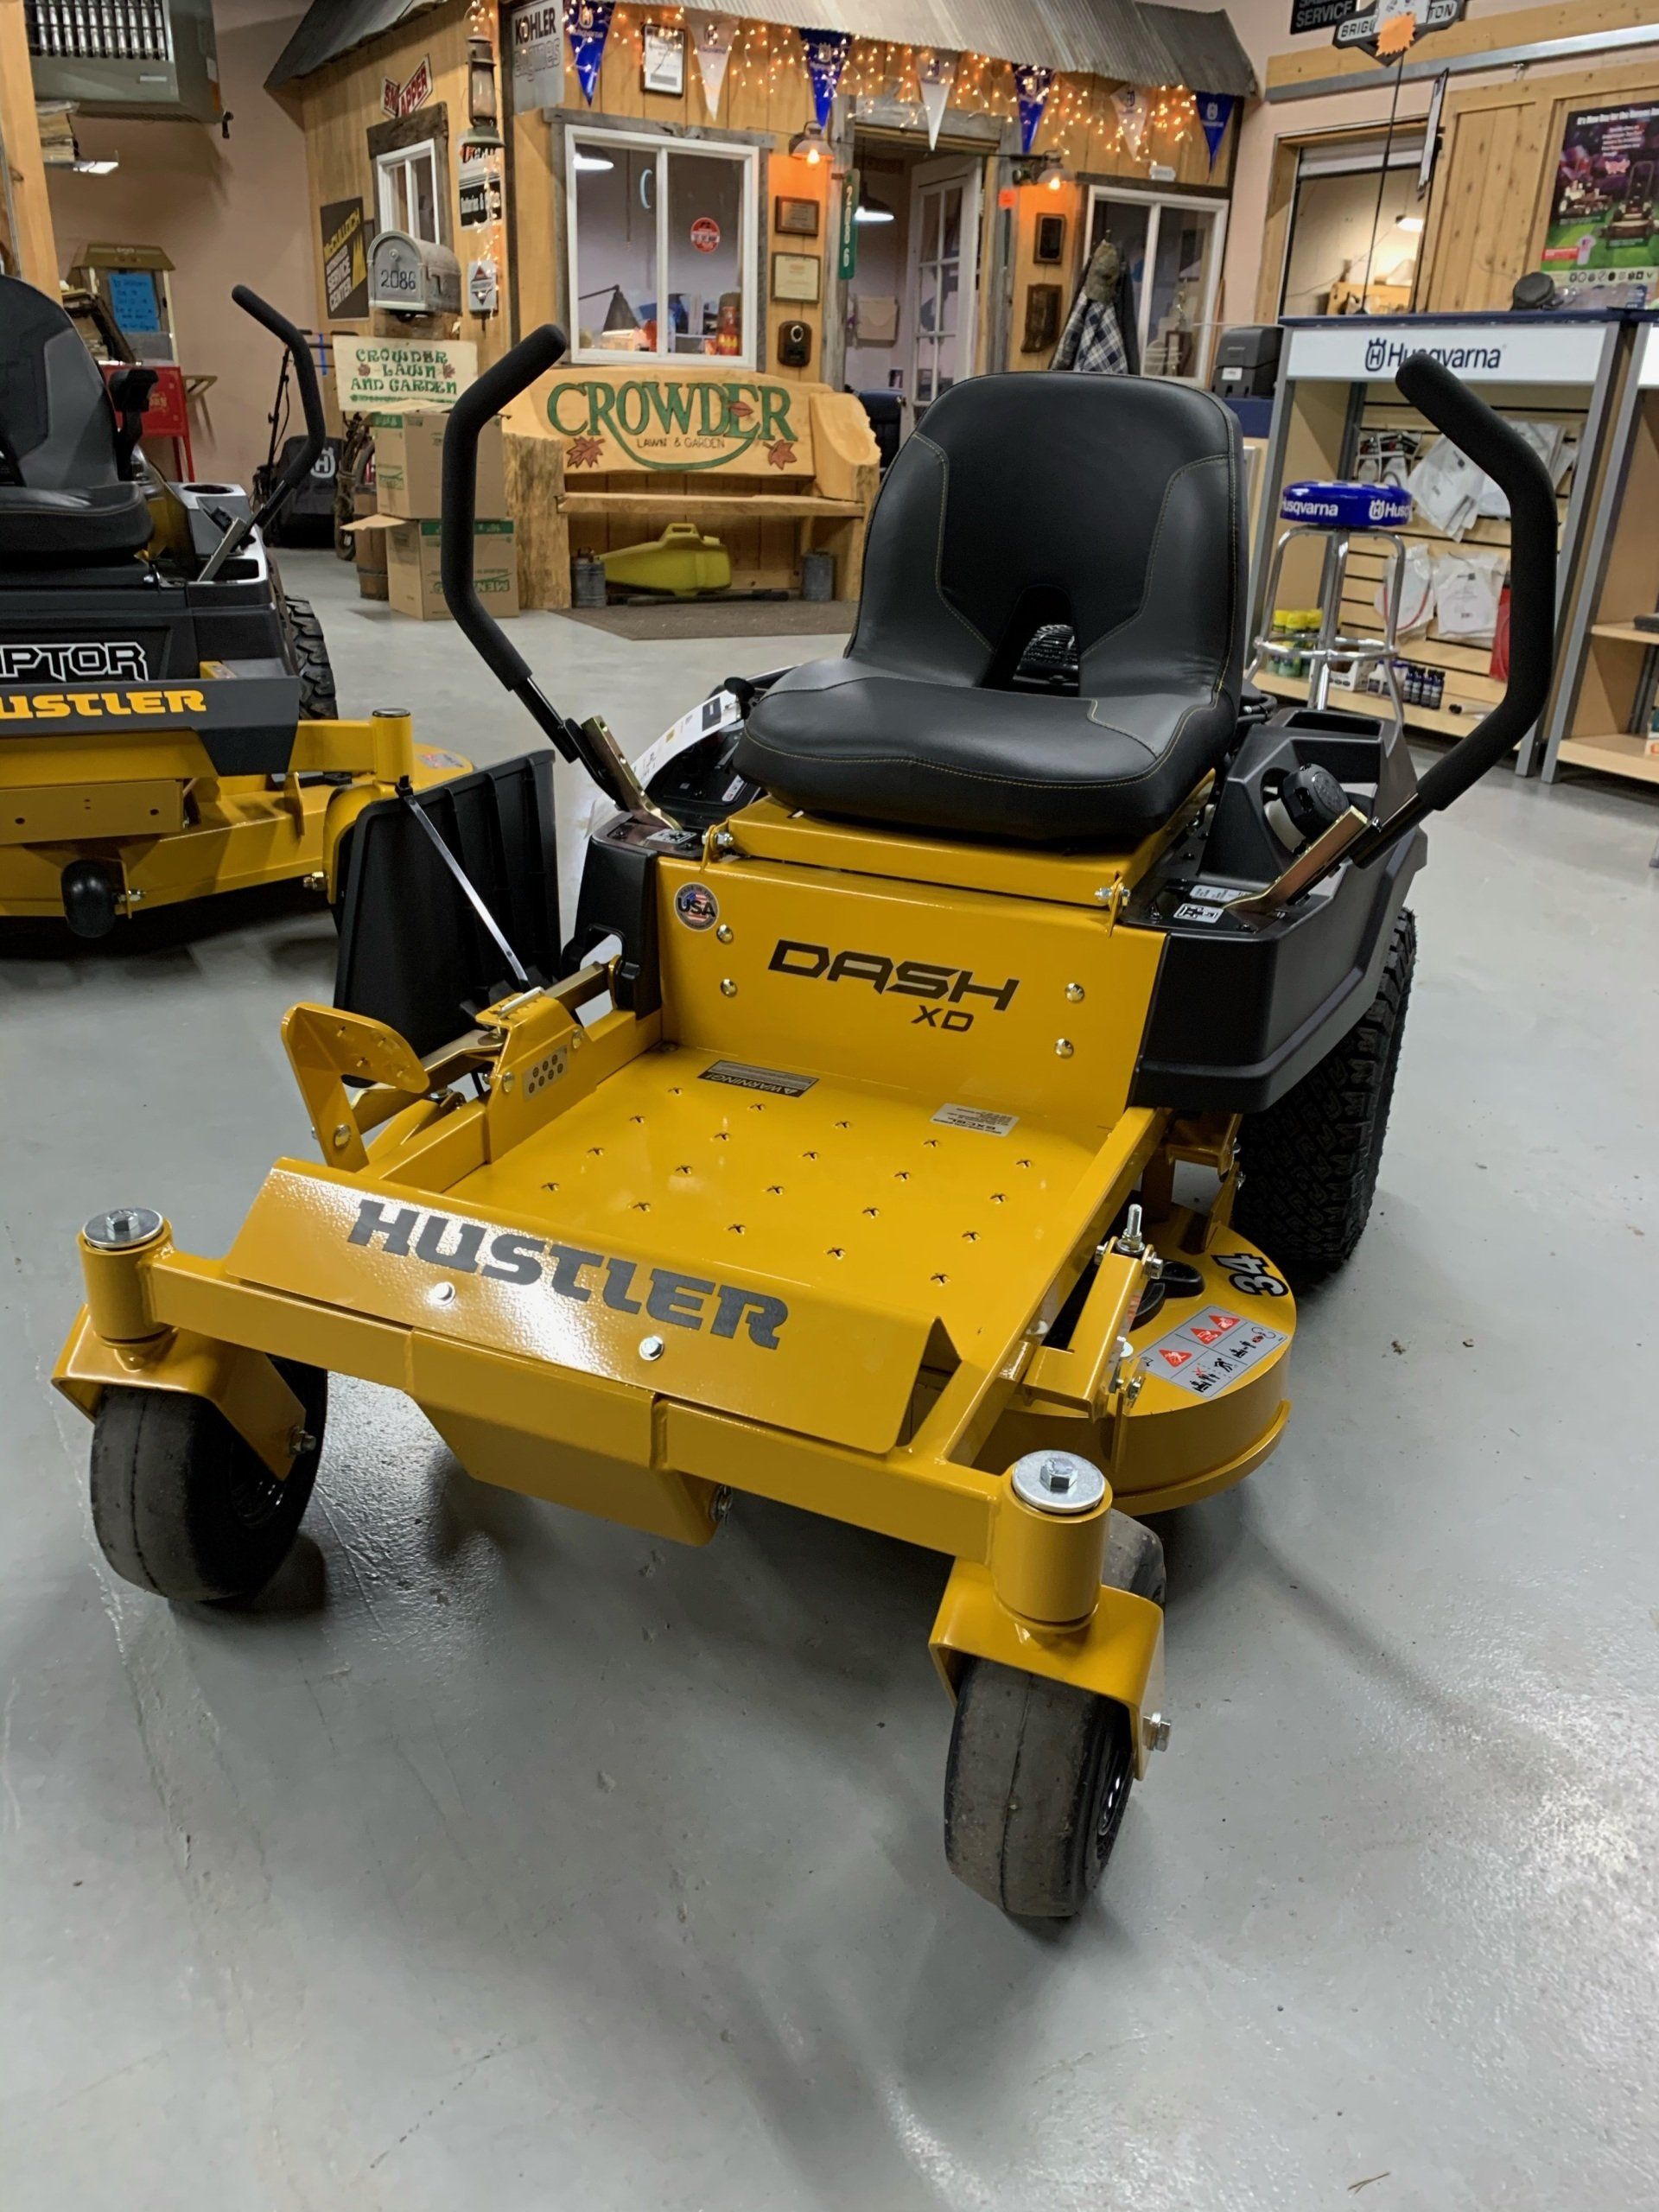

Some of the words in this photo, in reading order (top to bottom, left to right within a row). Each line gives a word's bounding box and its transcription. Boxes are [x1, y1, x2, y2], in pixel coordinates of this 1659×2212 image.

[515, 7, 556, 45] KOHLER
[1296, 1, 1352, 28] SERVICE
[1340, 19, 1376, 38] BRIG
[843, 185, 853, 268] 2086
[380, 269, 416, 290] 2086
[355, 347, 448, 365] CROWDER
[382, 363, 436, 378] LAWN
[350, 378, 385, 391] AND
[389, 378, 457, 395] GARDEN
[547, 380, 798, 442] CROWDER
[637, 436, 668, 448] LAWN
[674, 436, 682, 448] &
[684, 436, 726, 449] GARDEN
[0, 642, 149, 683] PTOR
[0, 690, 207, 719] USTLER
[677, 897, 716, 918] USA
[767, 938, 1020, 1012] DASH
[910, 1004, 975, 1033] XD
[707, 1072, 783, 1093] WARNING!
[347, 1198, 789, 1350] HUSTLER
[1211, 1253, 1289, 1297] 34
